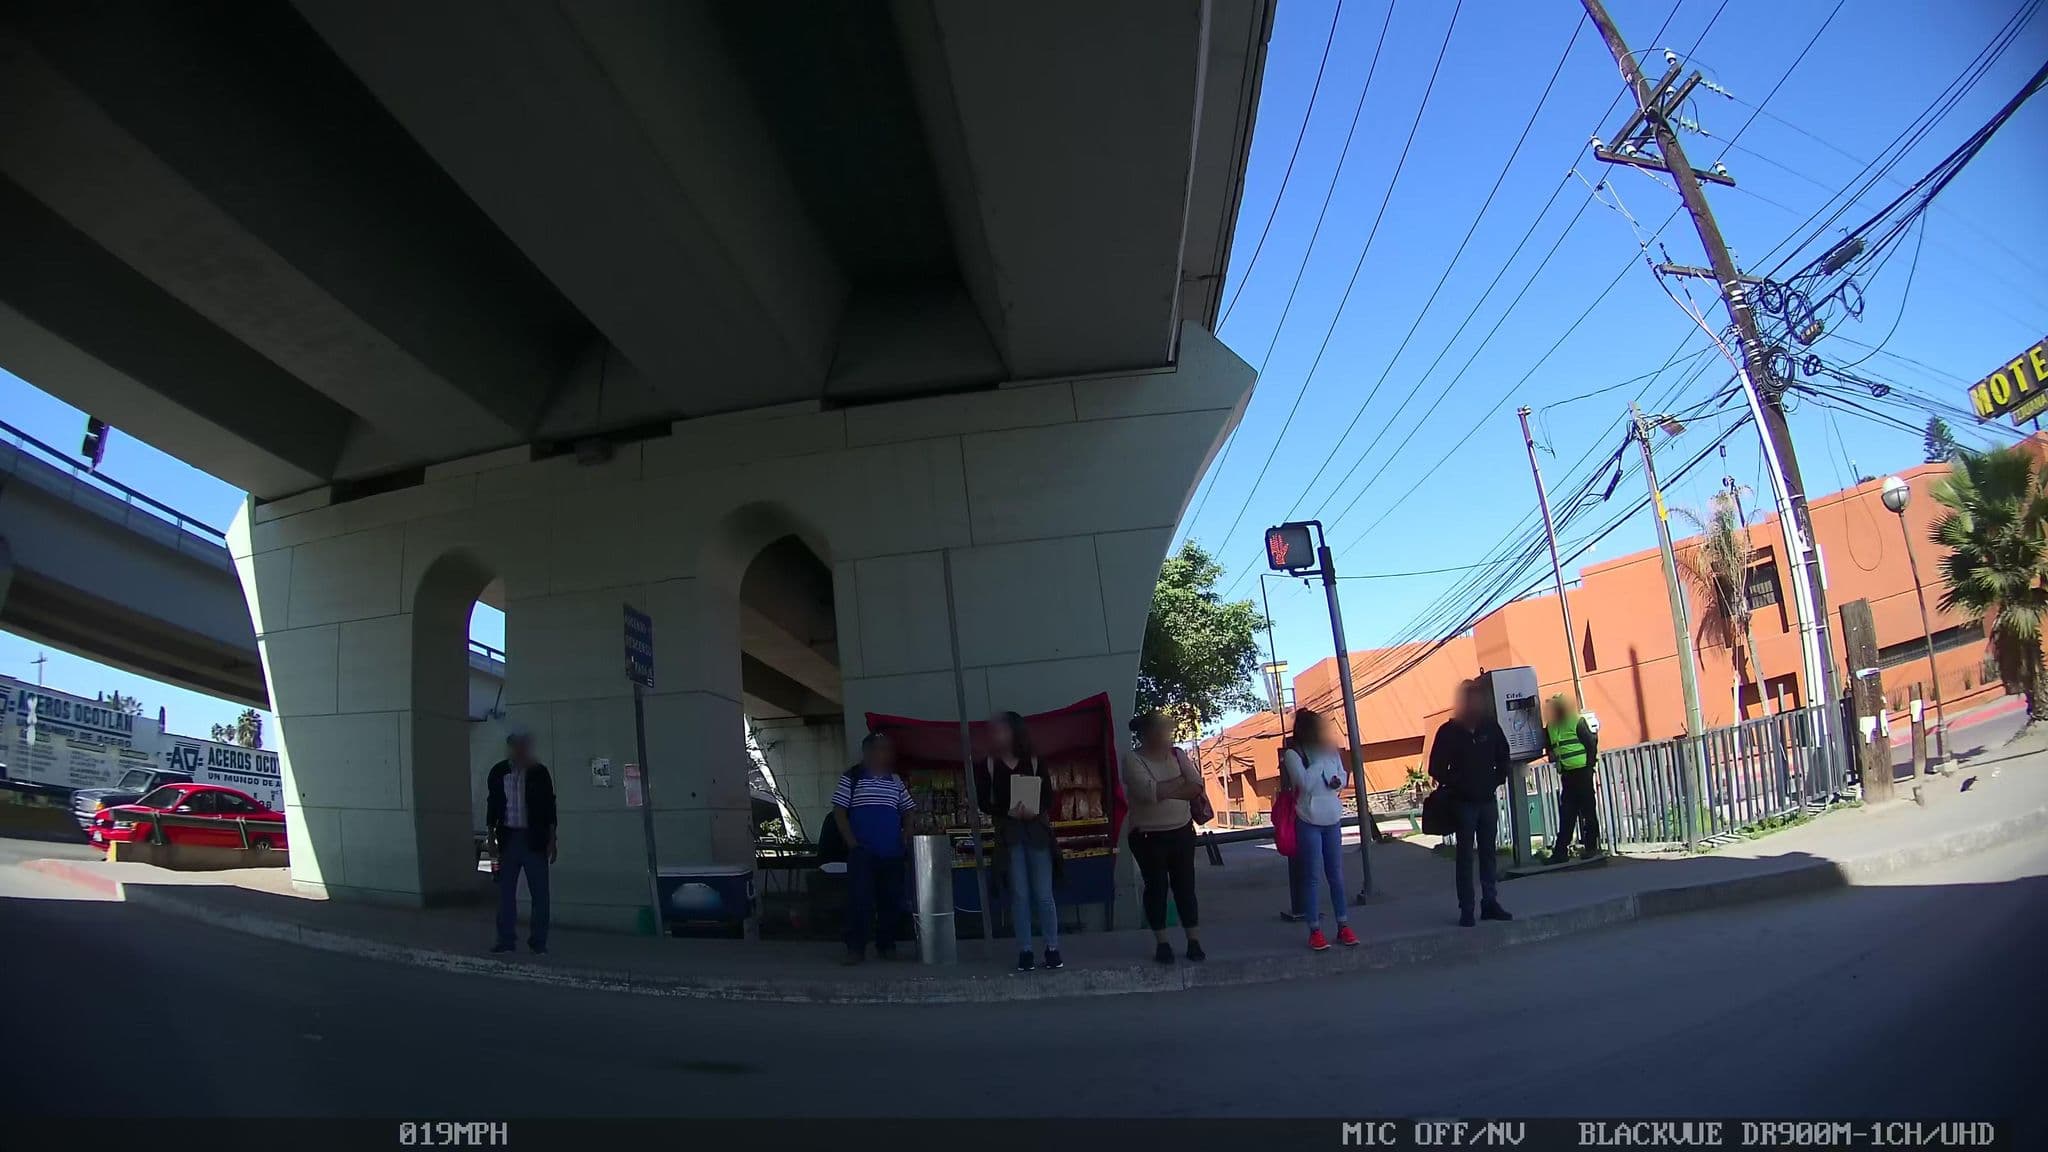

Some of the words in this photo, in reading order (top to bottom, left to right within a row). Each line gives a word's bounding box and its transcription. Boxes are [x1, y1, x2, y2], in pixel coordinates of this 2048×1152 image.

[208, 747, 251, 770] ACEROS
[208, 772, 221, 781] UN
[224, 776, 260, 786] MUNDO
[262, 779, 274, 787] DE
